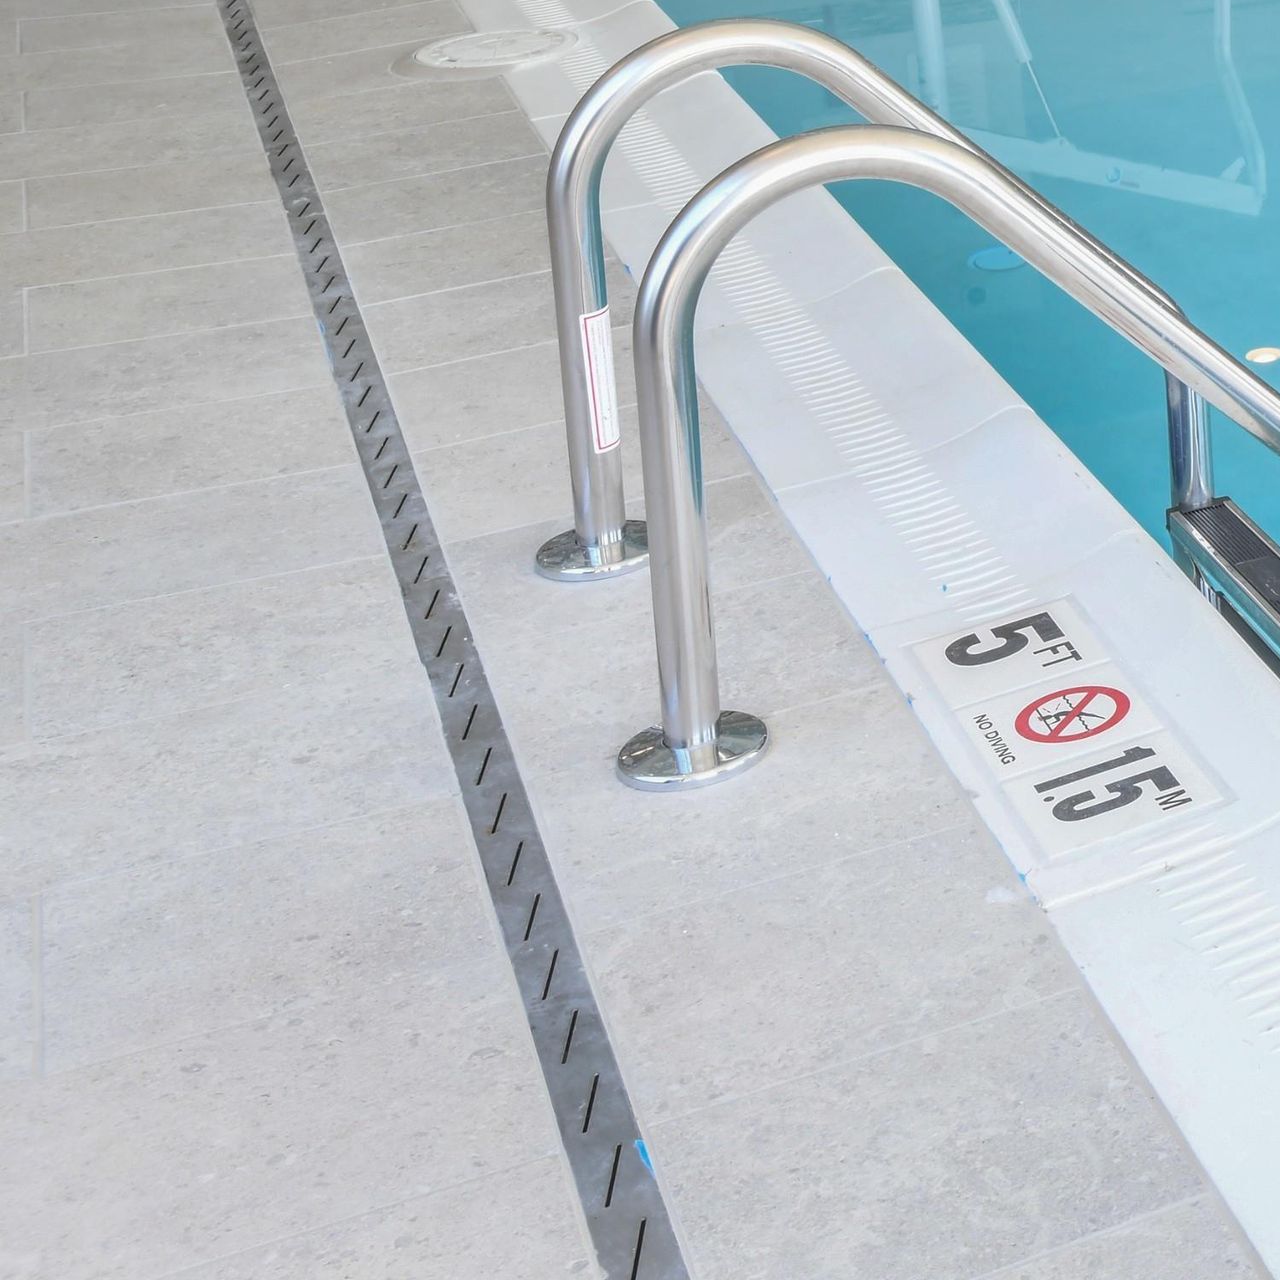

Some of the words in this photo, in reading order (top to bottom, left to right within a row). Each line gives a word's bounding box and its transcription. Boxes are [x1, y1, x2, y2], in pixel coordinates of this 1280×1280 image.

[944, 611, 1066, 667] 5
[1033, 640, 1083, 668] FT
[973, 714, 993, 730] NO
[985, 730, 1016, 764] DIVING
[1034, 746, 1181, 822] 1.5
[1154, 789, 1193, 810] M
